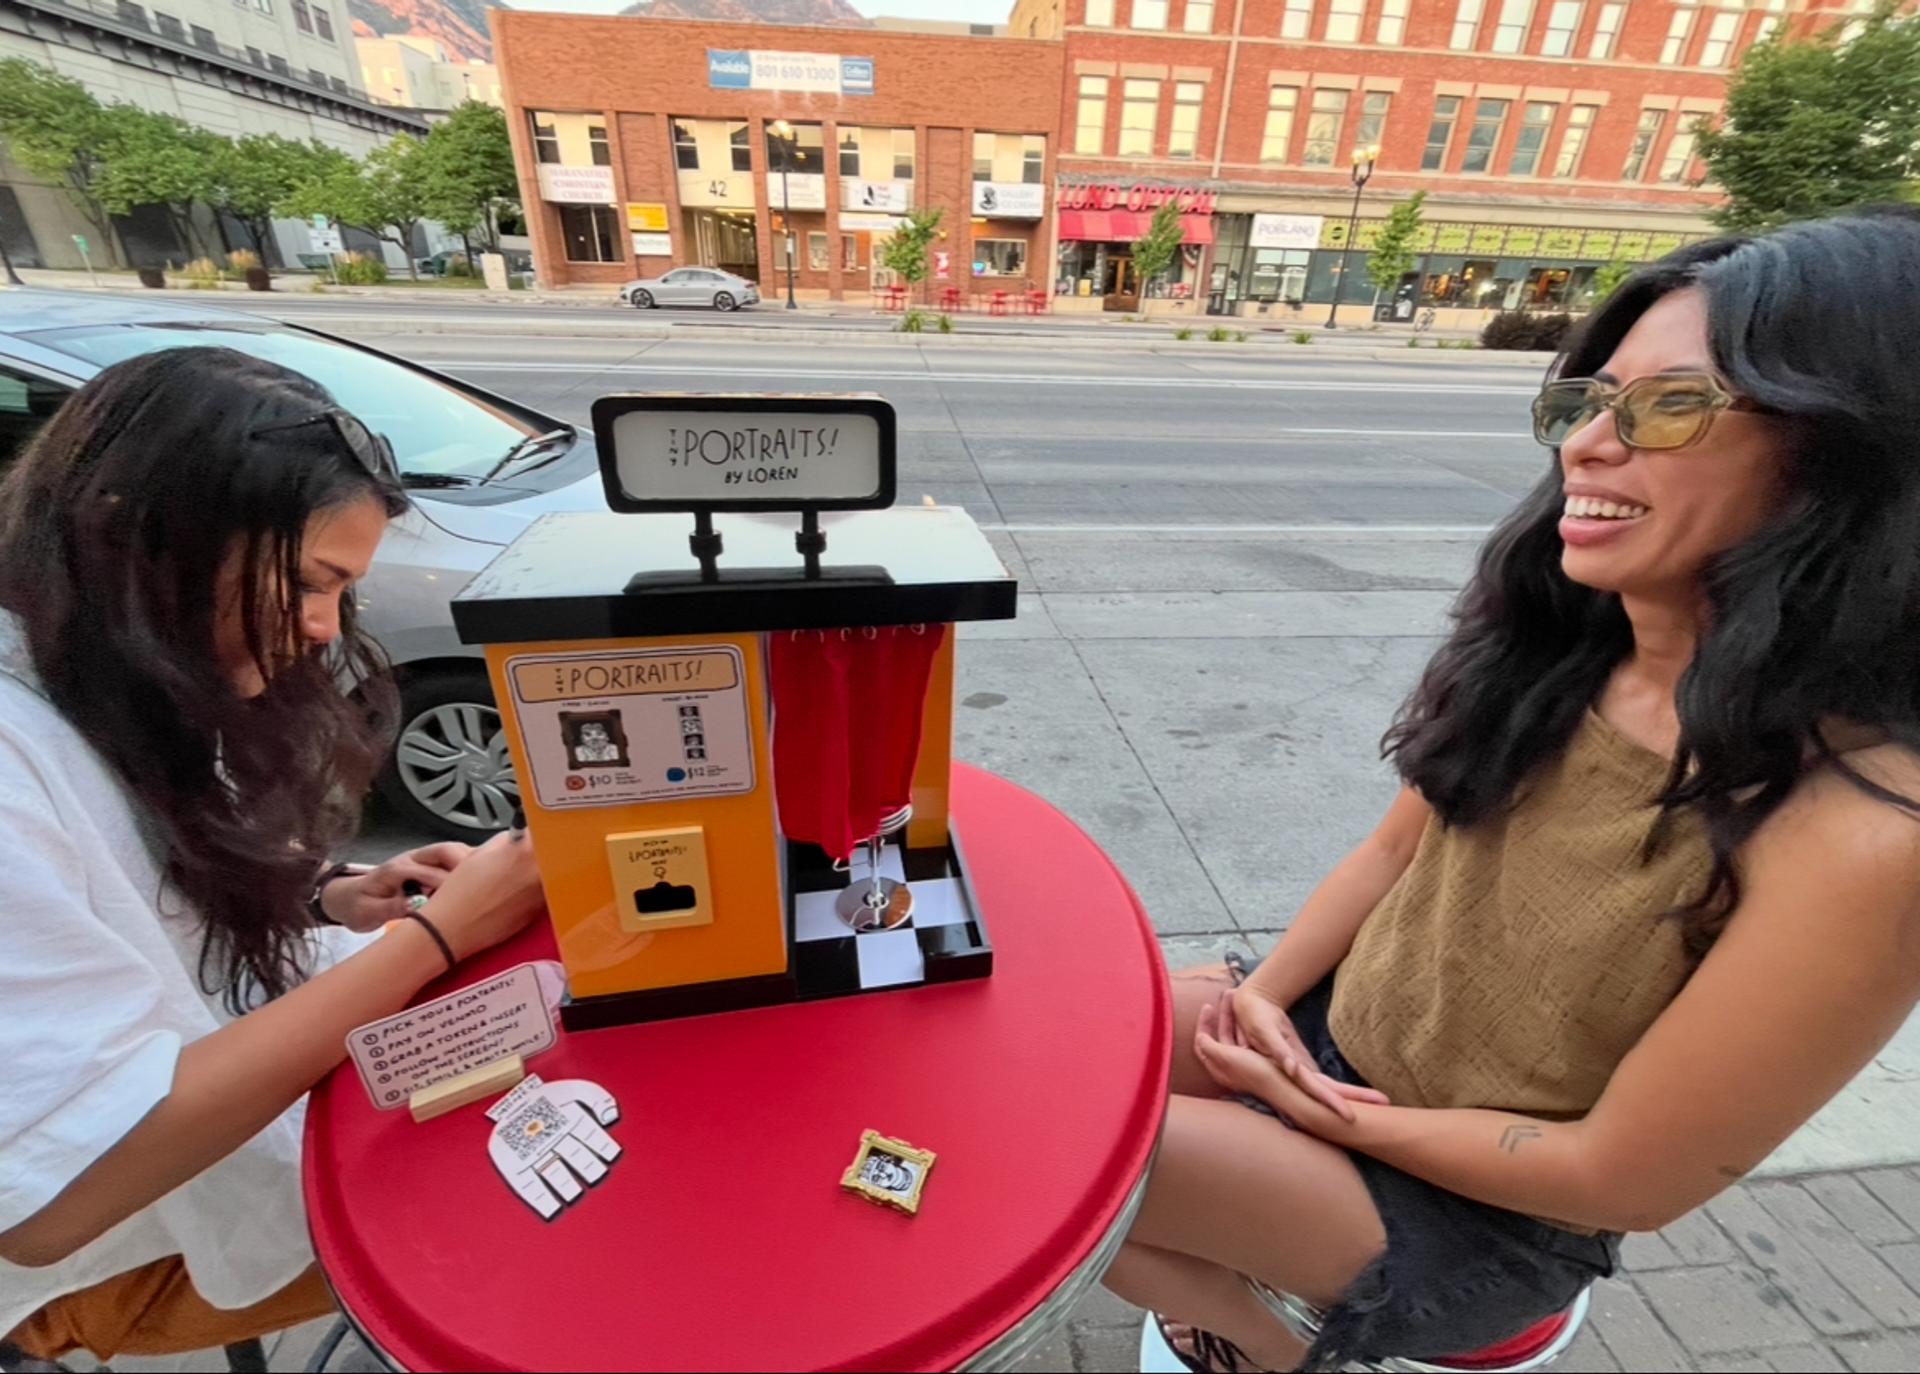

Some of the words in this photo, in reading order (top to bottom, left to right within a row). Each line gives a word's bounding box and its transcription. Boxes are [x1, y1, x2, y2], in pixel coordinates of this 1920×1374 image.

[709, 180, 728, 197] 42
[1058, 184, 1119, 209] LUND
[1127, 183, 1217, 215] OPTICAL
[684, 428, 839, 467] PORTRAITS!
[725, 470, 743, 484] BY
[747, 466, 798, 484] LOREN
[570, 660, 703, 693] PORTRAITS!
[588, 775, 612, 788] $10
[687, 767, 705, 780] $12
[382, 1020, 414, 1039] PICK
[418, 1004, 453, 1022] YOUR
[457, 978, 515, 1008] PORTRAITS!
[388, 1035, 412, 1051] PAY
[417, 1027, 435, 1039] ON
[440, 1004, 488, 1029] VENMO
[391, 1047, 422, 1065] GRAB
[437, 1025, 478, 1045] TOKEN
[490, 1002, 528, 1023] INSERT
[394, 1055, 439, 1077] FOLLOW
[443, 1020, 520, 1056] INSTRUCTIONS
[411, 1069, 430, 1080] ON
[435, 1059, 454, 1071] THE
